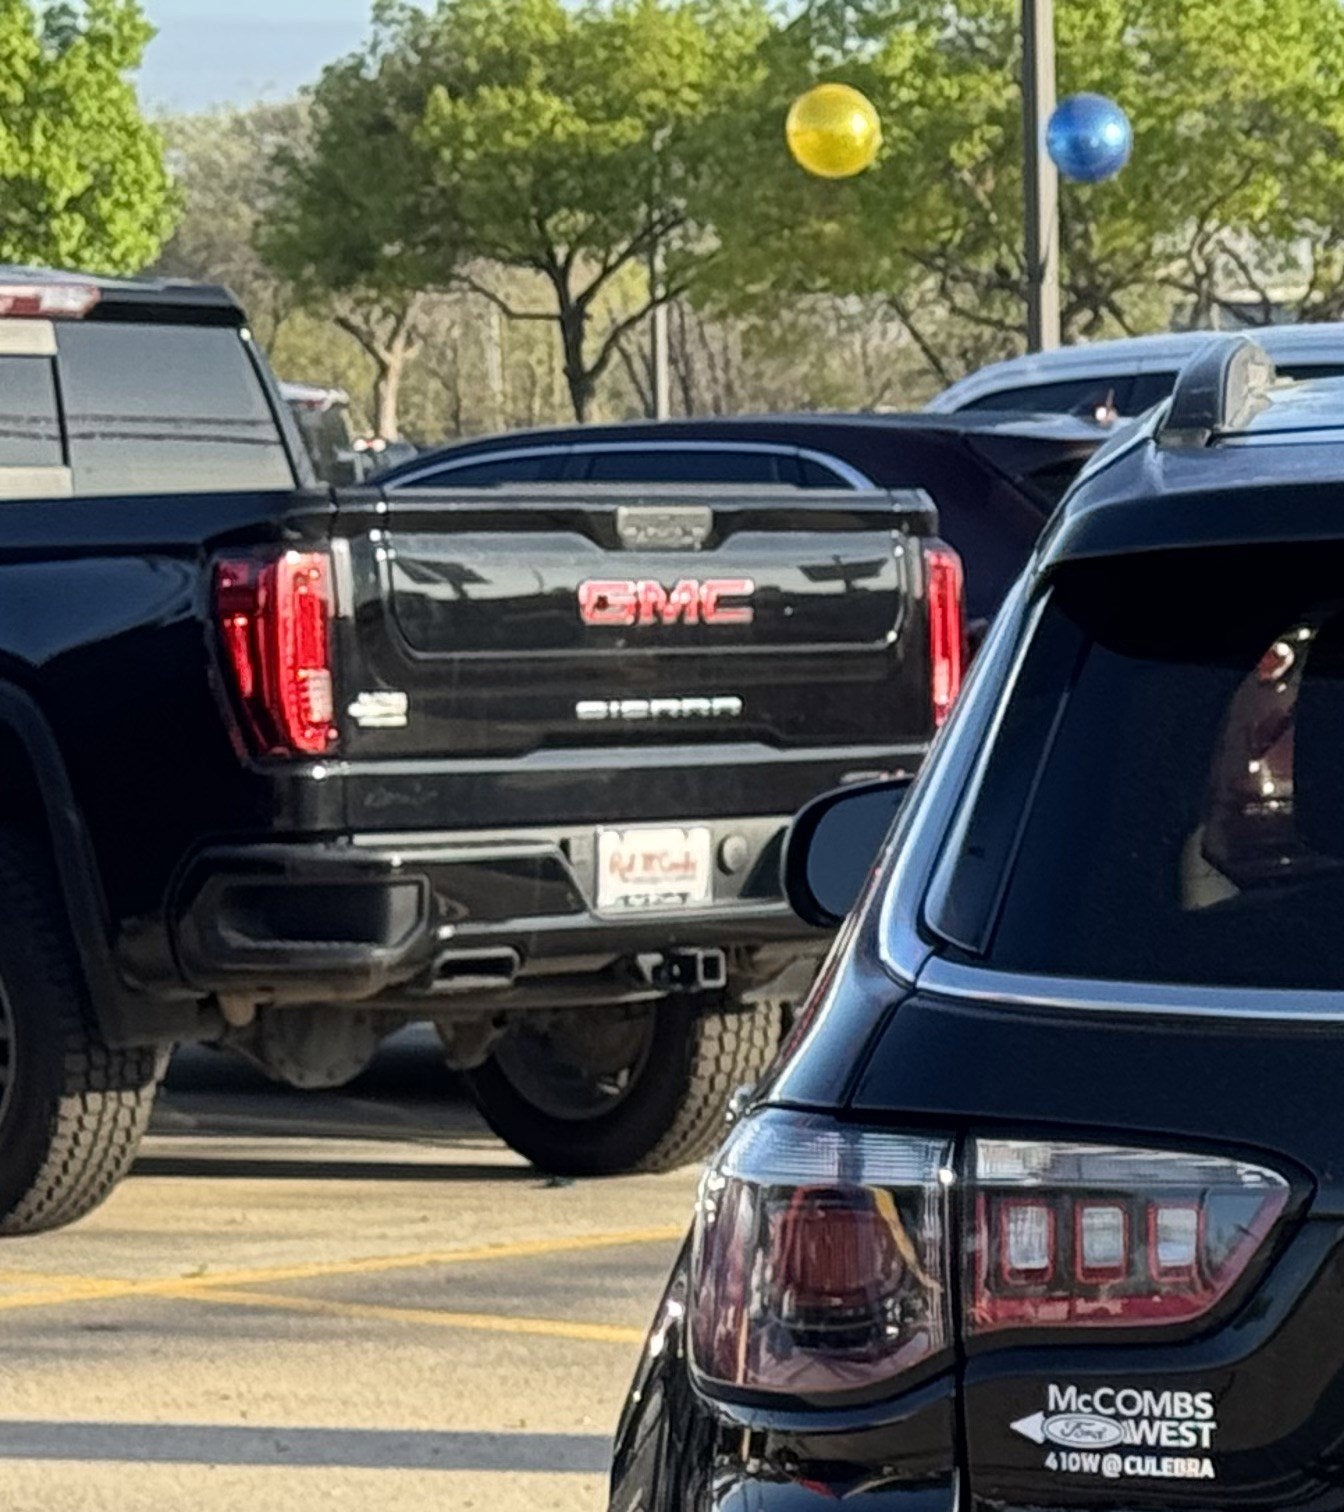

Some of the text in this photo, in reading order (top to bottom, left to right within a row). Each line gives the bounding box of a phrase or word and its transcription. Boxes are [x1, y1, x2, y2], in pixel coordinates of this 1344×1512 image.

[579, 578, 755, 626] GMC
[1048, 1384, 1214, 1419] McCOMBS
[1060, 1419, 1217, 1448] Ford WEST
